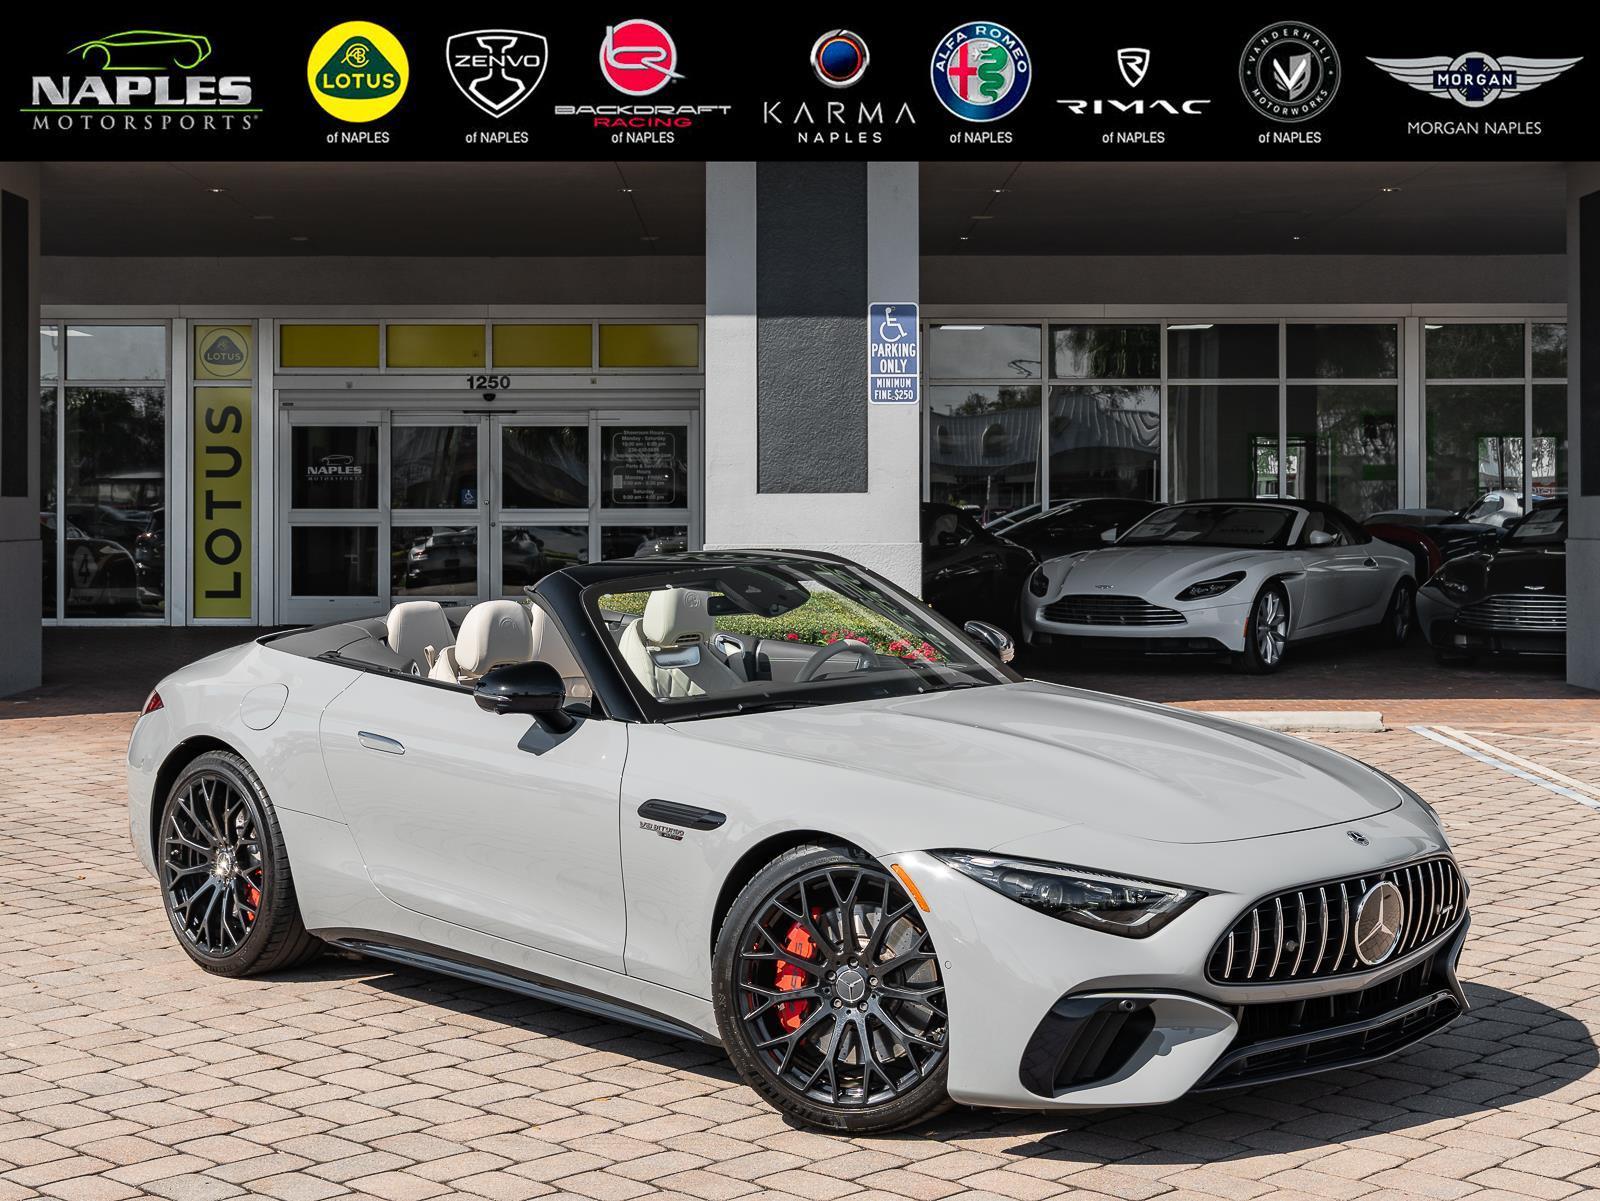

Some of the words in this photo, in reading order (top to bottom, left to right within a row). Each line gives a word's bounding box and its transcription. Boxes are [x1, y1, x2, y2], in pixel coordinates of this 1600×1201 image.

[207, 352, 241, 361] LOTUS
[871, 343, 917, 357] PARKING
[880, 358, 908, 373] ONLY
[466, 375, 511, 390] 1250
[876, 377, 912, 389] MINIMUM
[874, 389, 892, 400] FINE
[895, 389, 914, 401] $250
[307, 466, 363, 477] NAPLES
[204, 405, 243, 600] LOTUS
